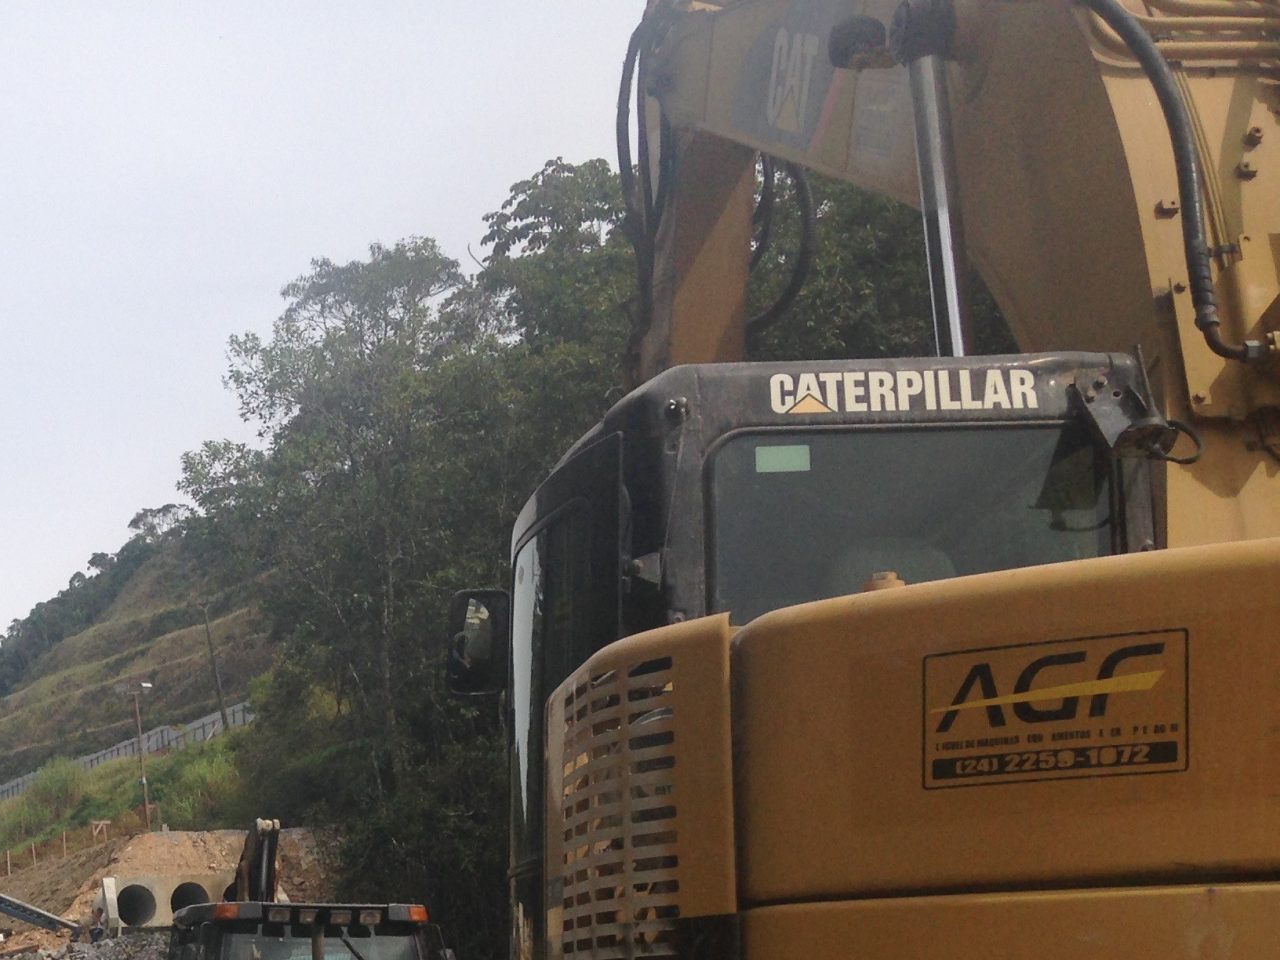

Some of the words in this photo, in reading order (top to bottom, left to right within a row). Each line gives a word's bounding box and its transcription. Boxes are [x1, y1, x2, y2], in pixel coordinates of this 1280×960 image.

[767, 28, 819, 135] CAT
[770, 369, 1039, 414] CATERPILLAR
[936, 642, 1165, 733] AGF
[956, 757, 1000, 775] (24)
